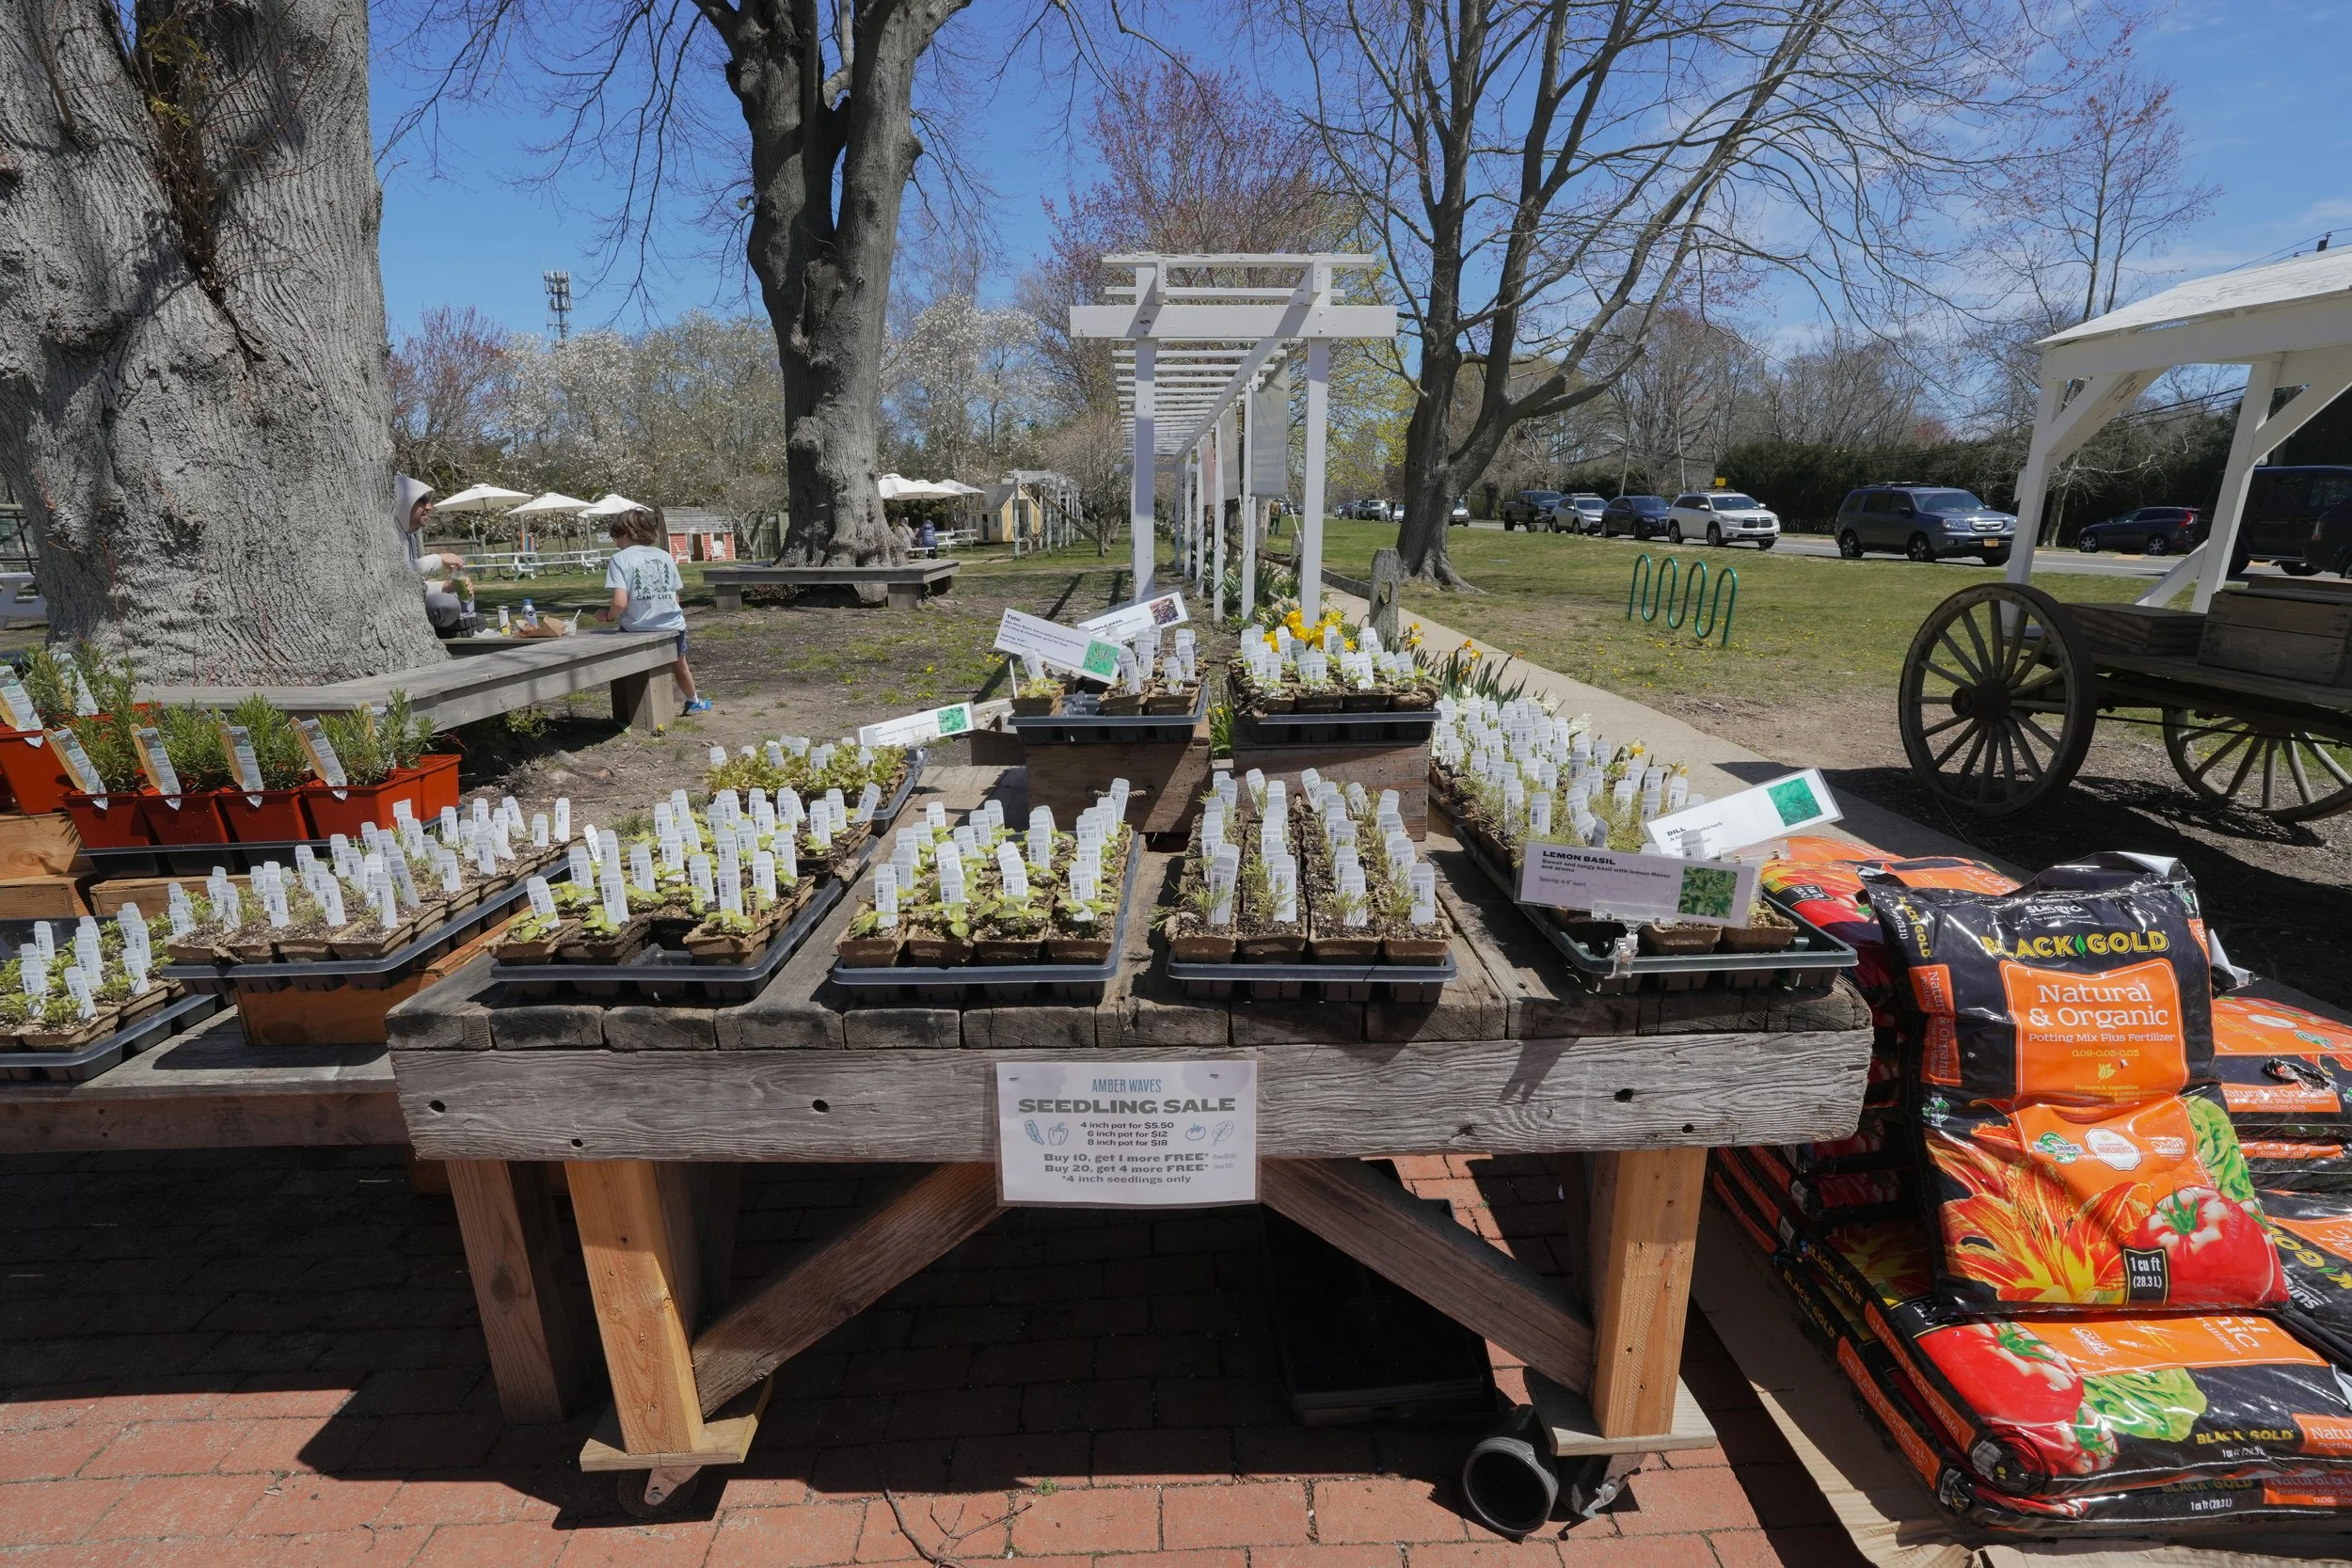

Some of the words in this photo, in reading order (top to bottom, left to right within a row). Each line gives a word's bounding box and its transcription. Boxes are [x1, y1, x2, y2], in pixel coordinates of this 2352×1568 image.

[1667, 827, 1686, 836] DILL
[1542, 858, 1563, 866] Sweet
[1577, 863, 1596, 871] tangy
[1543, 850, 1581, 862] LEMON
[1583, 856, 1616, 865] BASIL
[1915, 925, 1931, 958] GOLD
[1980, 934, 2076, 958] BLACK
[2086, 930, 2169, 955] GOLD
[1919, 975, 1932, 1007] Potting
[2037, 982, 2153, 1004] Natural
[2028, 1007, 2054, 1026] &
[2057, 1005, 2169, 1029] Organic
[1929, 971, 1947, 1016] Natur
[1939, 1029, 1950, 1080] Organic
[2028, 1033, 2074, 1043] Potting
[2076, 1034, 2098, 1042] Mix
[2101, 1033, 2125, 1042] Plus
[2128, 1033, 2175, 1042] Fertilizer
[1092, 1079, 1126, 1093] AMBER
[1129, 1078, 1162, 1093] WAVES
[1018, 1099, 1158, 1114] SEEDLING
[1163, 1098, 1235, 1114] SALE
[1043, 1153, 1069, 1164] Buy
[1073, 1153, 1091, 1163] 10,
[1094, 1154, 1115, 1164] get
[1044, 1164, 1069, 1174] Buy
[1073, 1164, 1093, 1173] 20,
[1096, 1165, 1116, 1174] get
[1107, 1175, 1163, 1184] seedlings
[1166, 1175, 1191, 1183] only
[2130, 1257, 2137, 1271] 1
[2137, 1259, 2149, 1272] cu
[2151, 1257, 2161, 1272] ft
[2133, 1275, 2153, 1289] (28.3
[2153, 1275, 2163, 1289] L)
[2196, 1430, 2245, 1445] BLACK
[2249, 1429, 2295, 1441] GOLD
[2191, 1502, 2195, 1511] 1
[2202, 1500, 2209, 1511] ft
